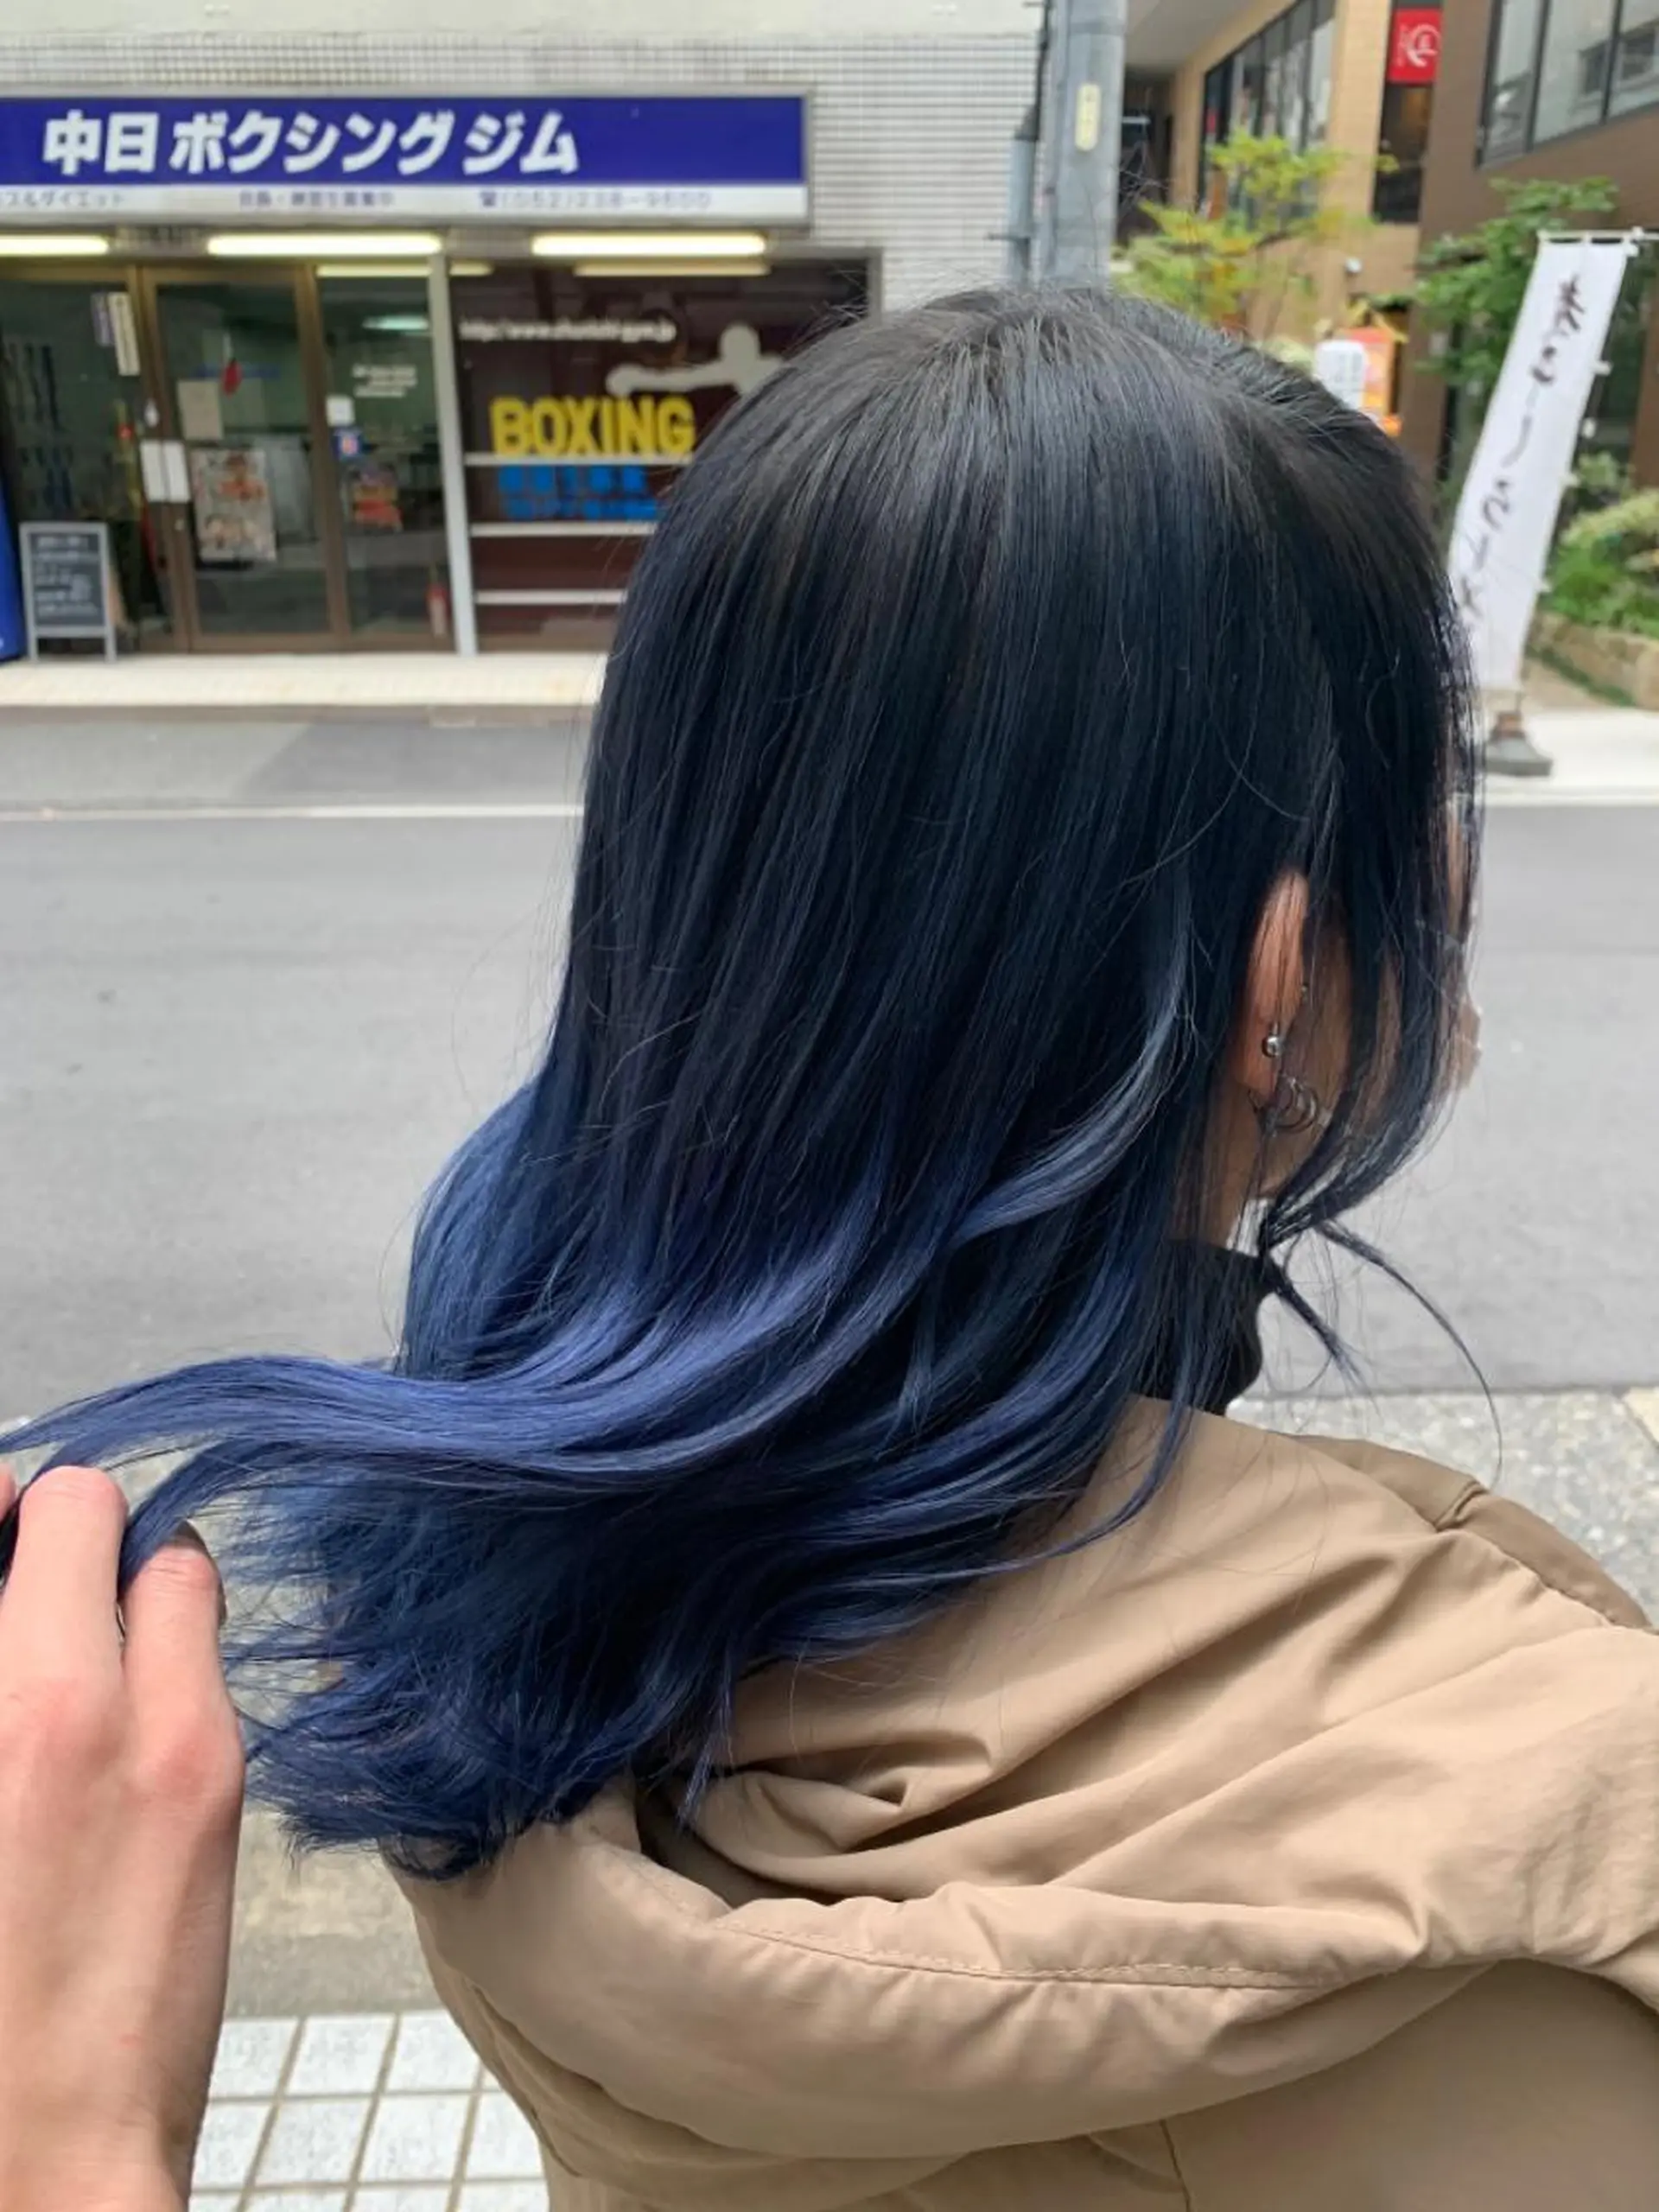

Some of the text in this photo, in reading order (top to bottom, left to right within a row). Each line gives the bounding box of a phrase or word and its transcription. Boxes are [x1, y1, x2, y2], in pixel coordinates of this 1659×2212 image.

[42, 109, 580, 176] 中日ボクシングジム
[489, 394, 696, 458] BOXING
